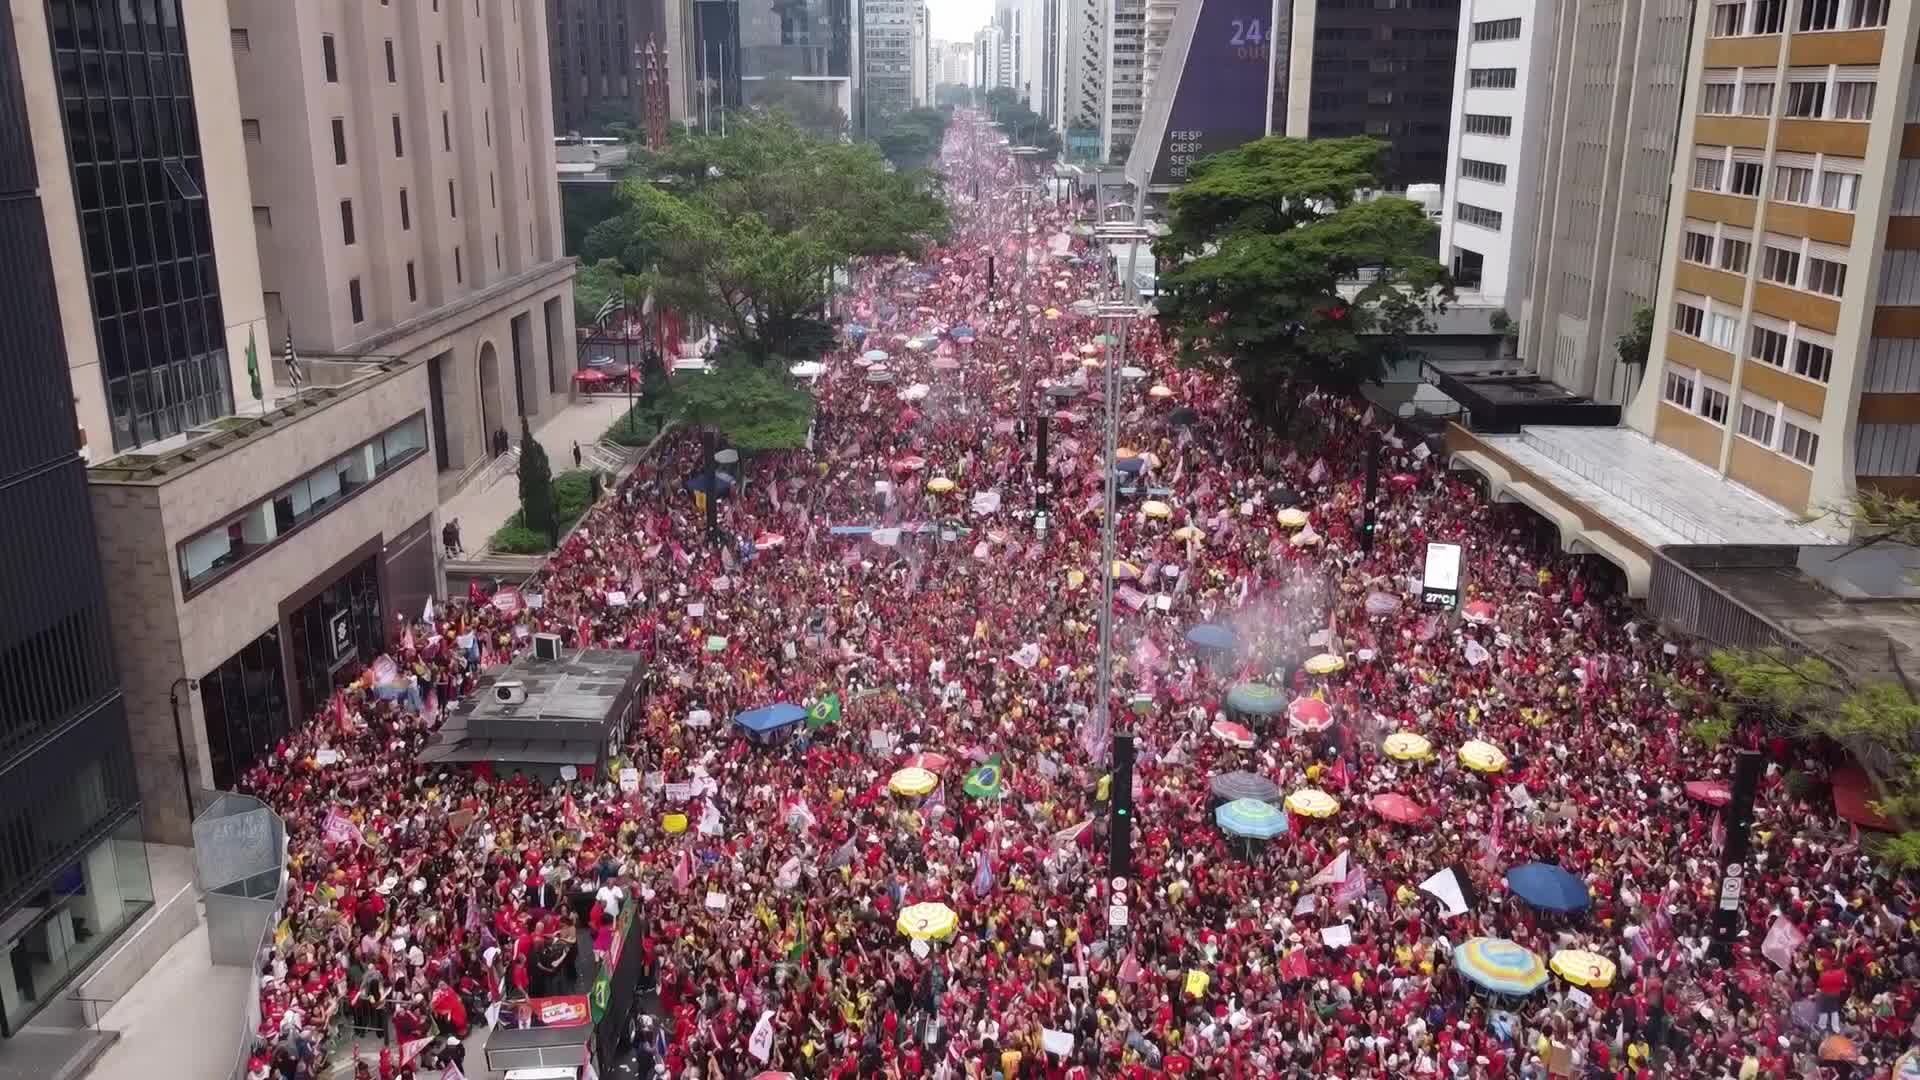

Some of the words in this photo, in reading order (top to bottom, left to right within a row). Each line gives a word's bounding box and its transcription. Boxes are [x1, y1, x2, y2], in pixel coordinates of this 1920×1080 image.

[1230, 19, 1263, 46] 24
[1171, 130, 1203, 141] FIESP
[1170, 142, 1203, 153] CIESP
